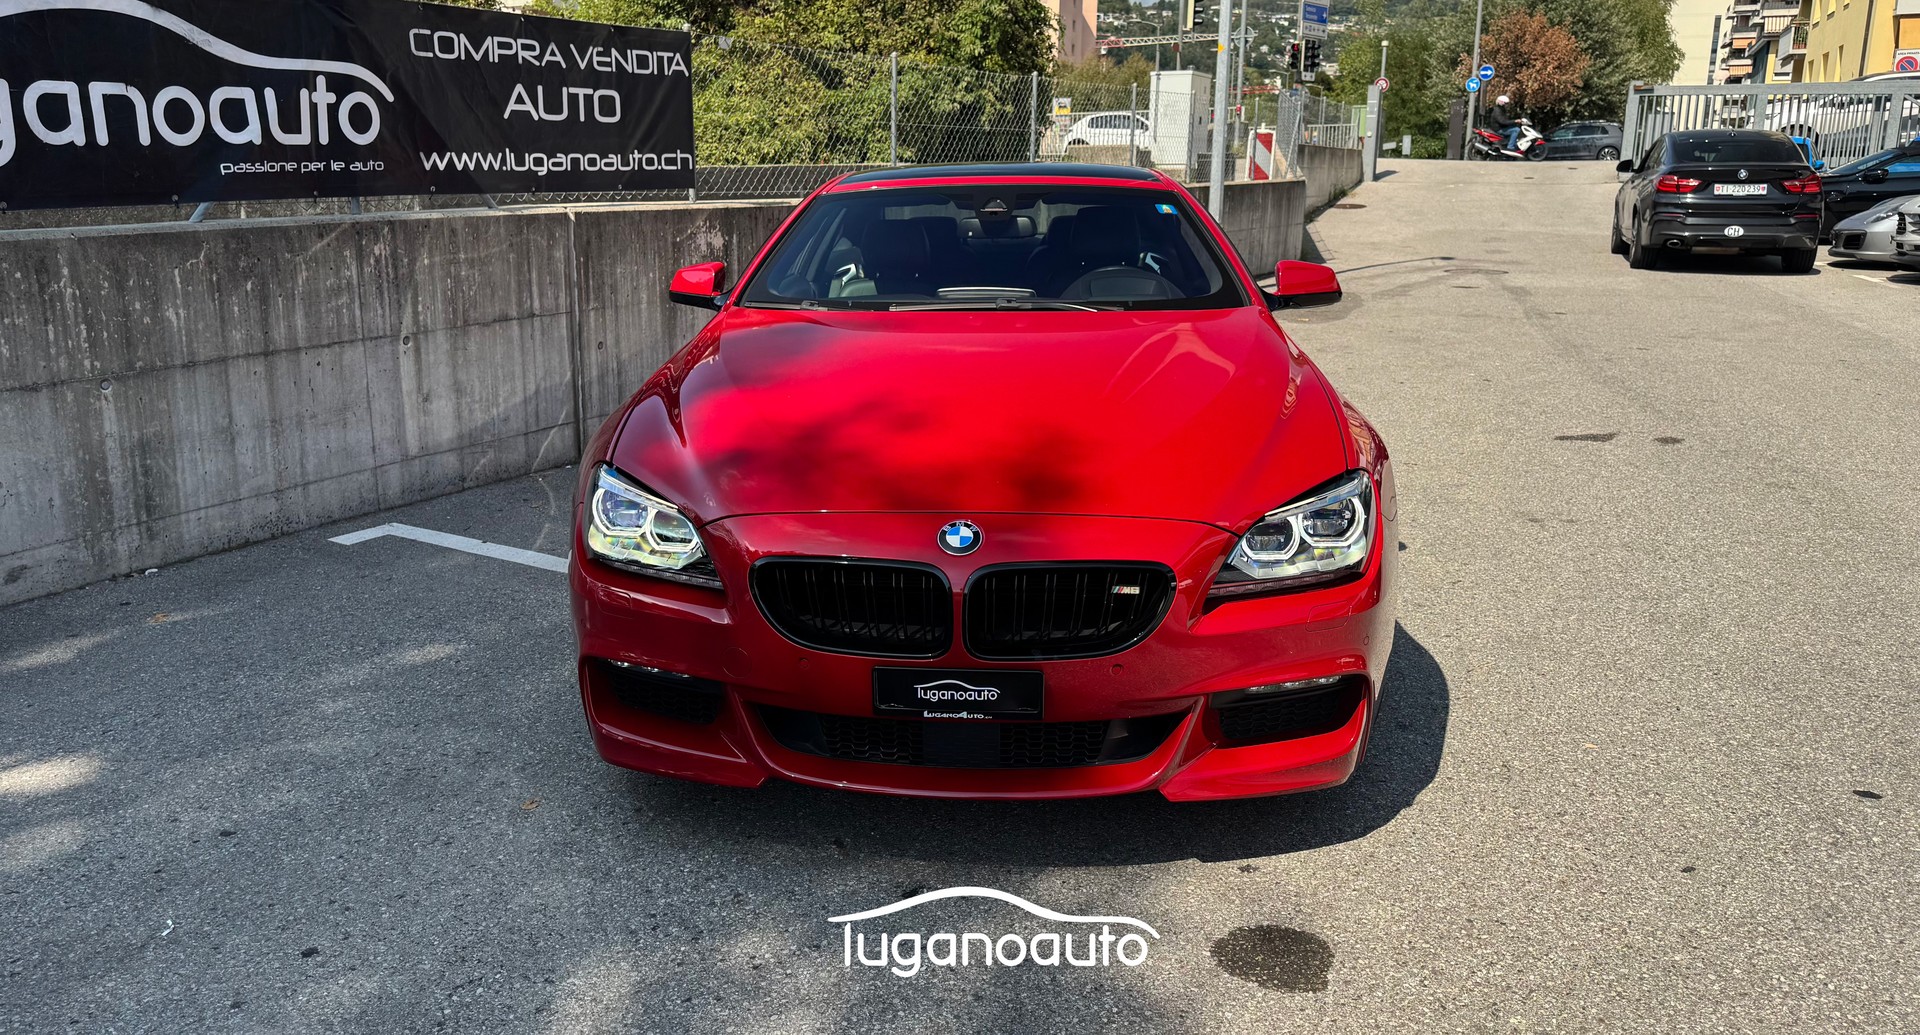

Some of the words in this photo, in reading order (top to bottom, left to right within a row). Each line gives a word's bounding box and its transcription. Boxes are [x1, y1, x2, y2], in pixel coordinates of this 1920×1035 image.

[408, 28, 567, 69] COMPRA
[569, 43, 689, 78] VENDITA
[503, 83, 622, 124] AUTO
[0, 75, 381, 167] anoauto
[220, 161, 298, 176] passione
[300, 161, 327, 174] per
[330, 160, 346, 172] le
[349, 160, 385, 172] auto
[419, 148, 693, 176] www.luganoauto.ch
[1727, 227, 1741, 237] CH
[942, 521, 978, 532] BMW
[917, 687, 998, 702] luganoauto
